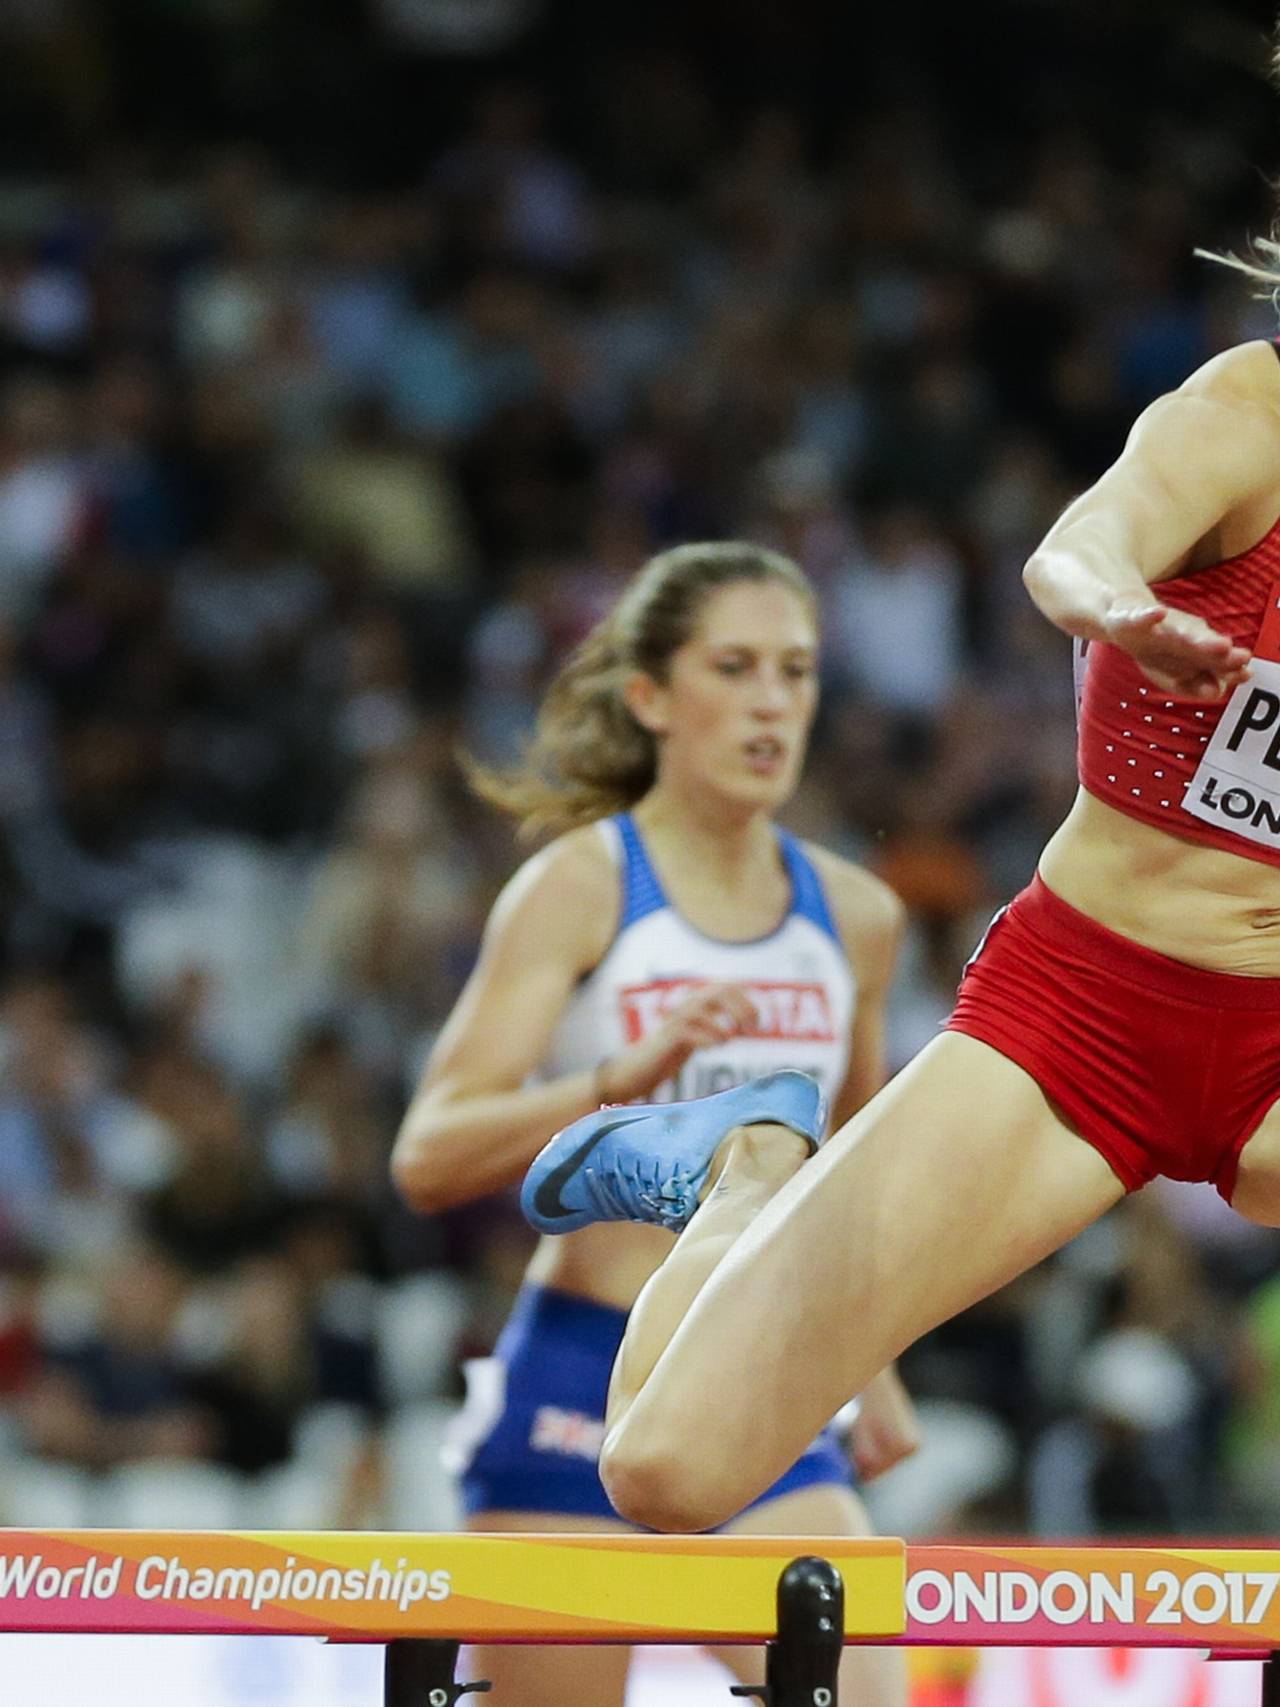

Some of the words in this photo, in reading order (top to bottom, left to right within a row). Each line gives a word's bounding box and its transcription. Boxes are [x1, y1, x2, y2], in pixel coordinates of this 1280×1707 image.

[0, 1556, 122, 1600] World
[134, 1556, 451, 1610] Championships
[905, 1569, 1135, 1624] ONDON
